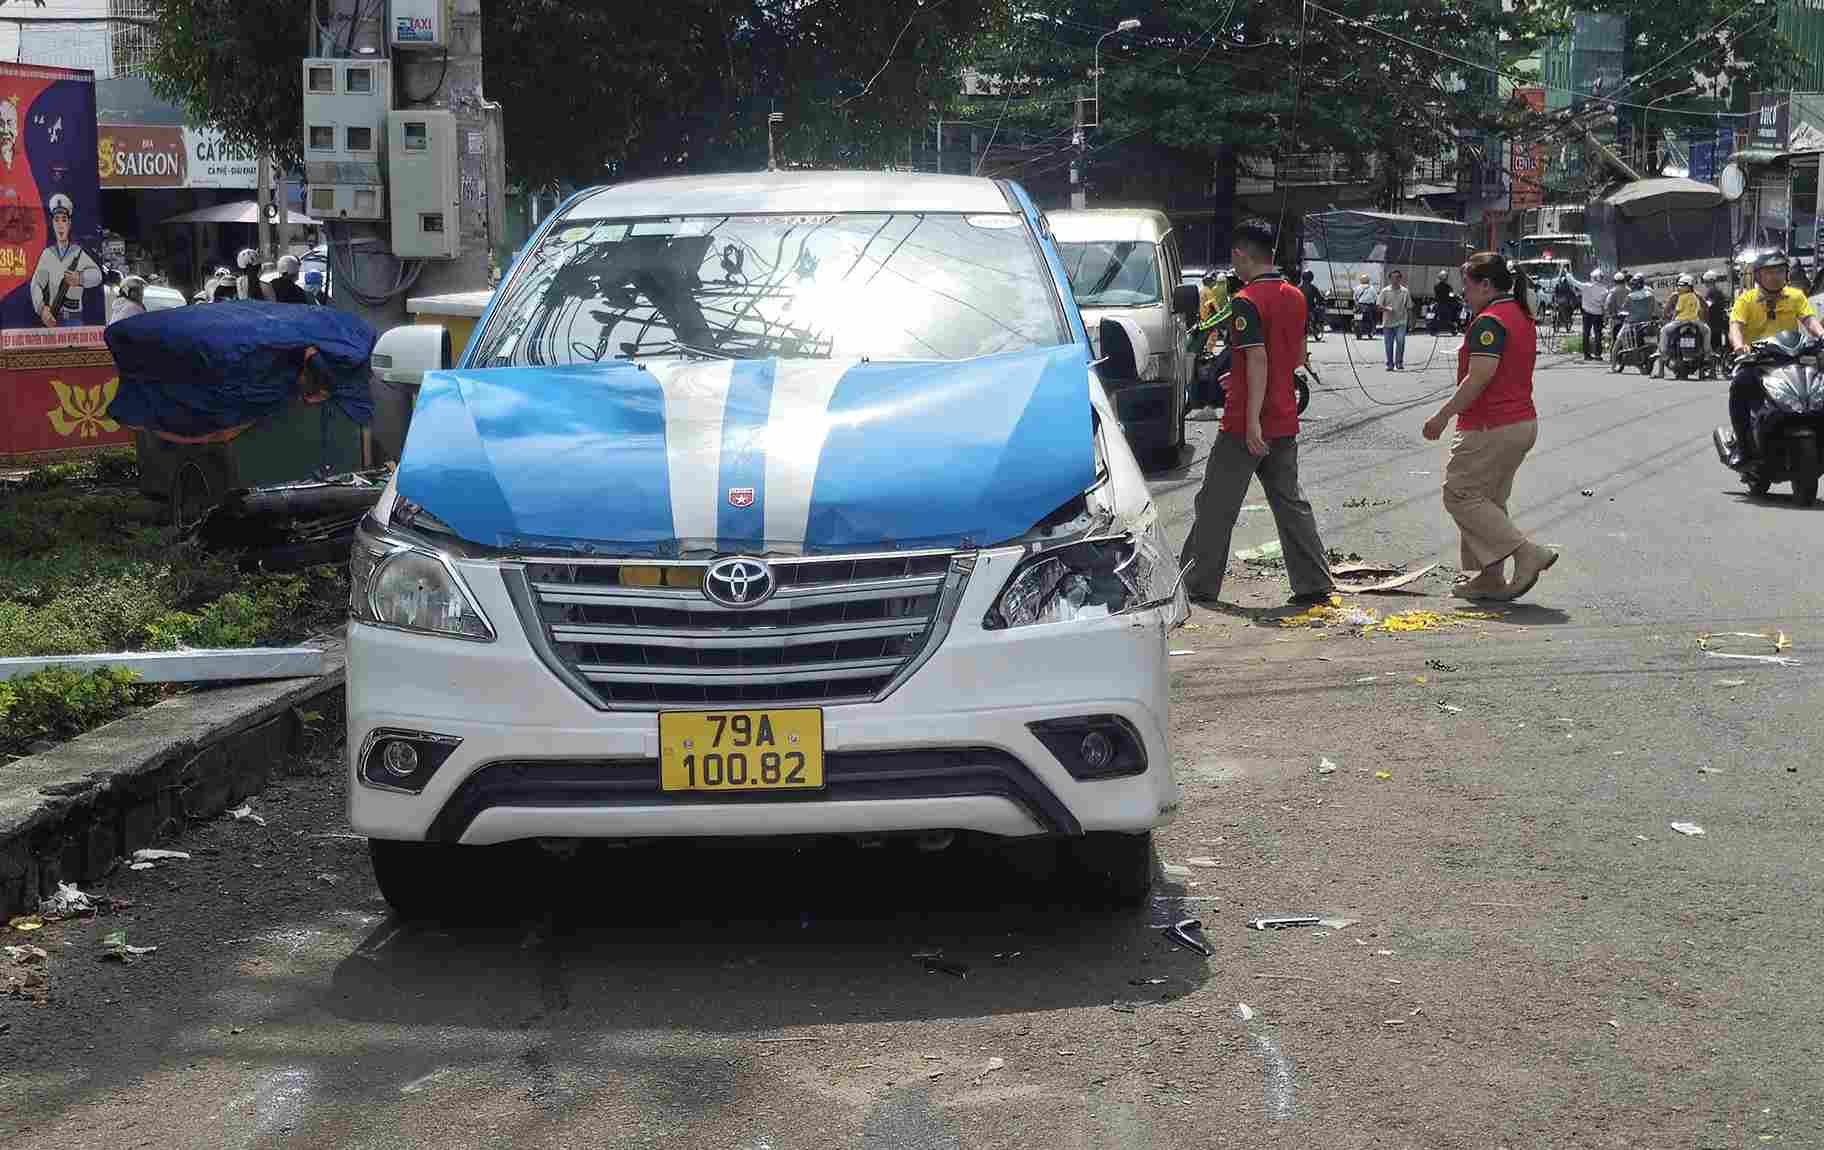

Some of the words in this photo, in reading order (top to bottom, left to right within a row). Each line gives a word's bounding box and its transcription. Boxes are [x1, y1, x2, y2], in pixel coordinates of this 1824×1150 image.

[116, 151, 179, 175] SAIGON
[704, 714, 775, 747] 79A
[683, 751, 806, 786] 100.82
